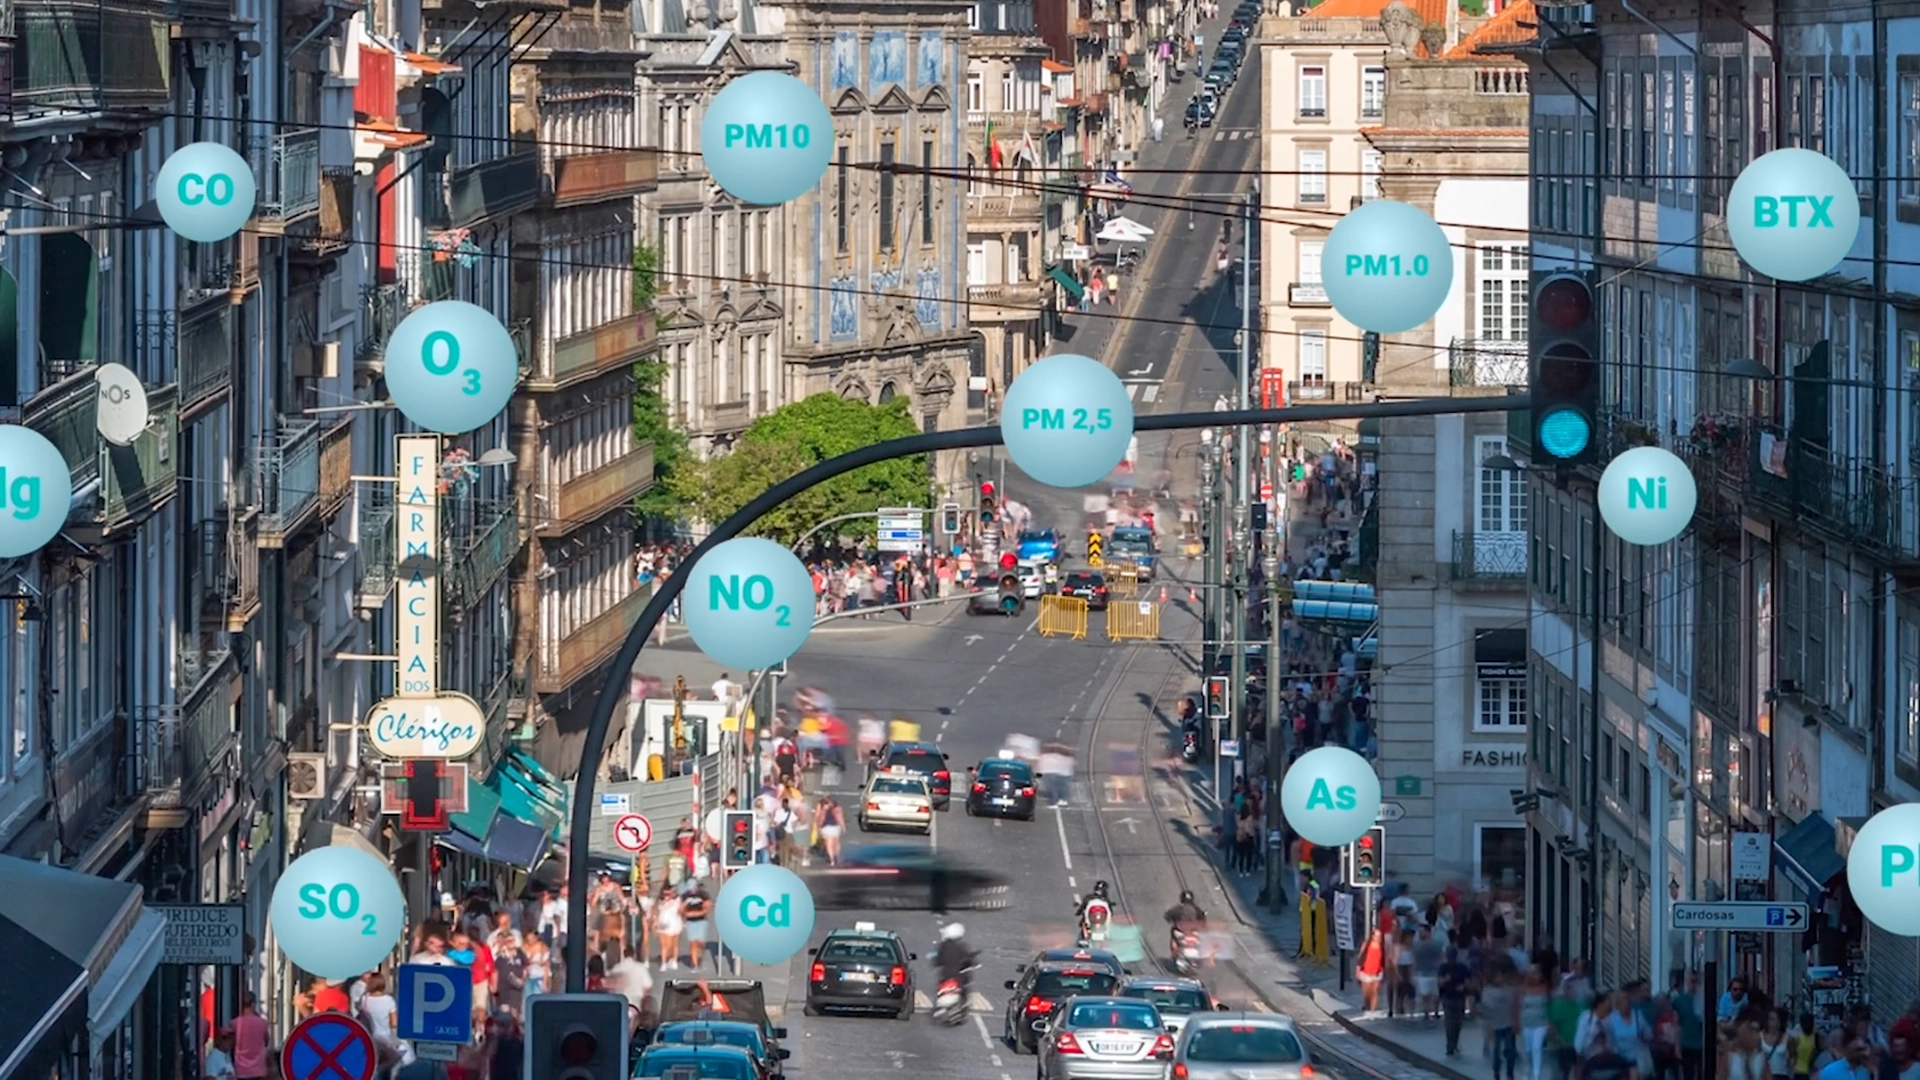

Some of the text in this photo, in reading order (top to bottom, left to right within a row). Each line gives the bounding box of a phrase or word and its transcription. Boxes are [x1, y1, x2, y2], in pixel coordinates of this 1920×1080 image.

[101, 384, 131, 404] NOS
[404, 681, 430, 692] DOS
[376, 713, 477, 750] Clérigos
[1676, 909, 1735, 921] Cardosas
[413, 971, 456, 1034] P
